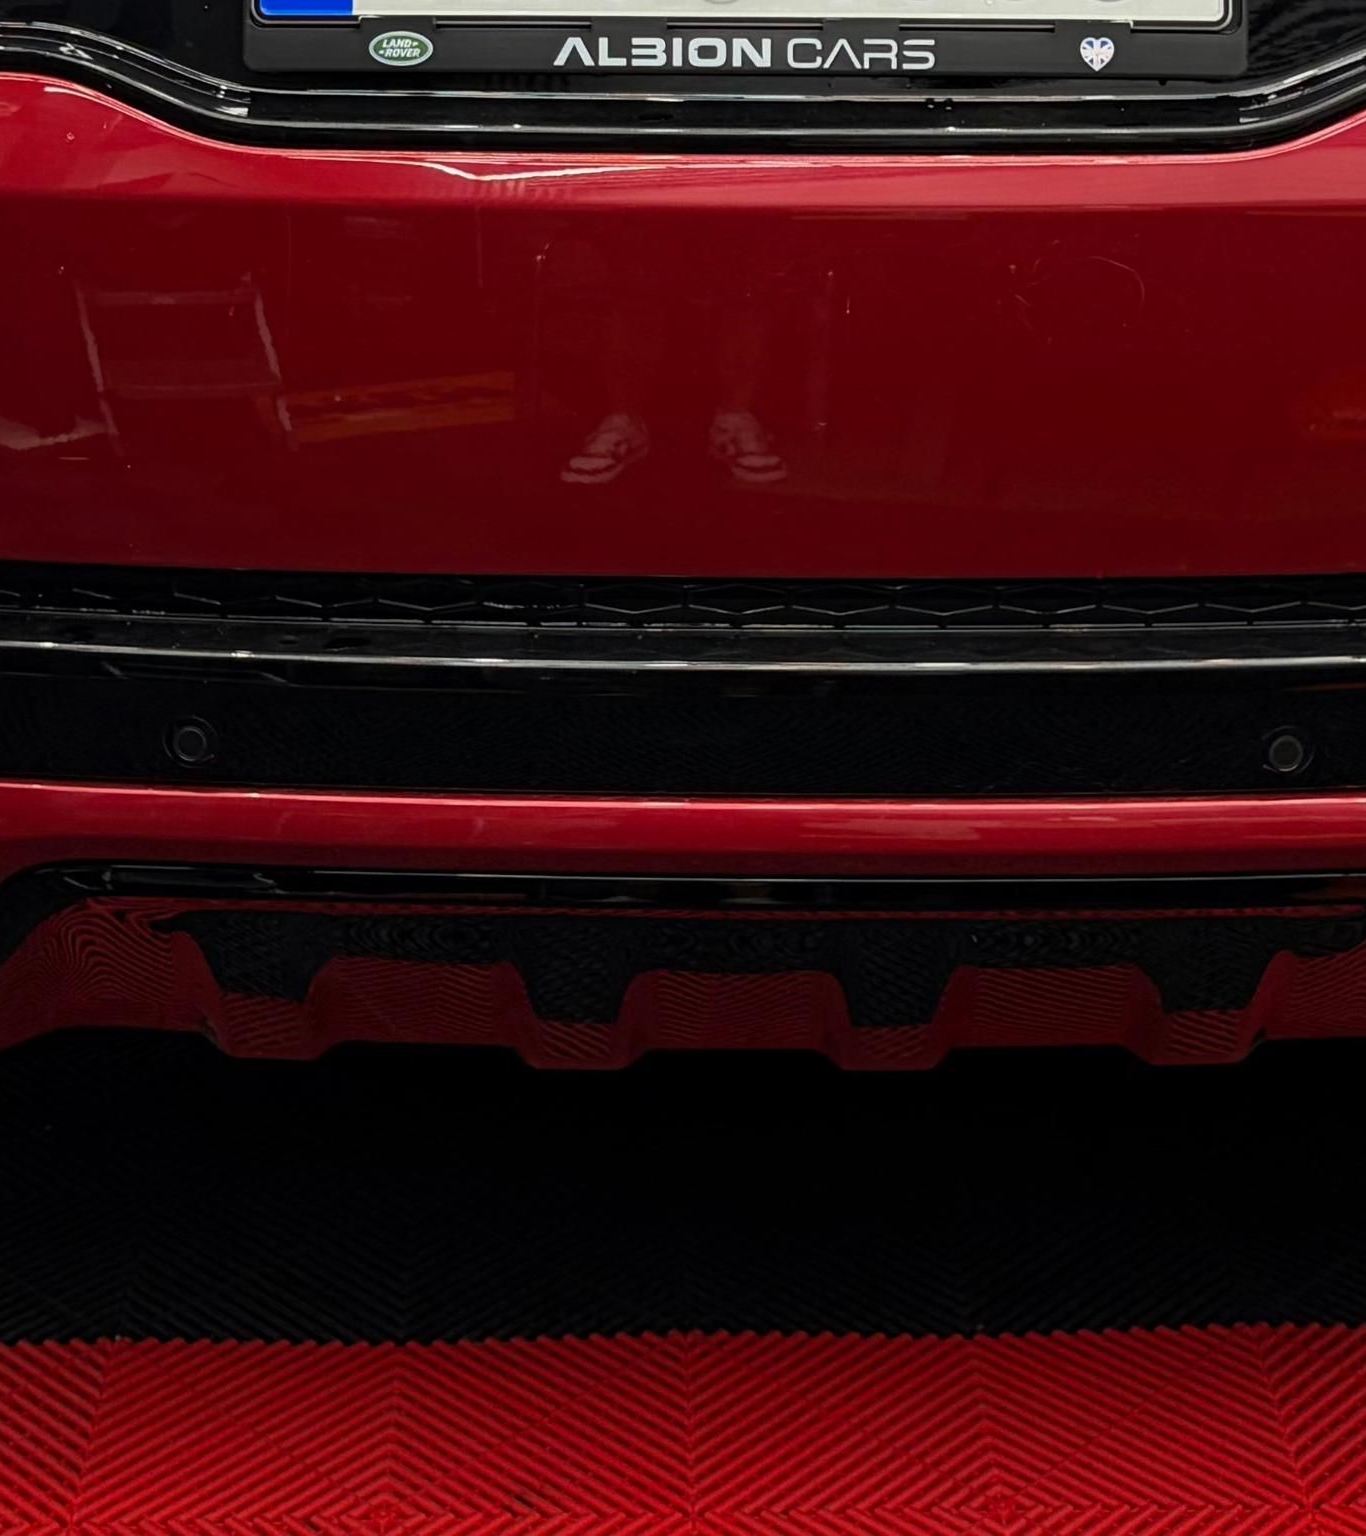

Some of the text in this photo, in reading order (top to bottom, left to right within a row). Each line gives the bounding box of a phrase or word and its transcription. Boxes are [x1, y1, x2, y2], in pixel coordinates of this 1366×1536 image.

[382, 38, 412, 48] LAND
[384, 48, 421, 58] ROVER
[553, 37, 936, 70] ALBION CARS
